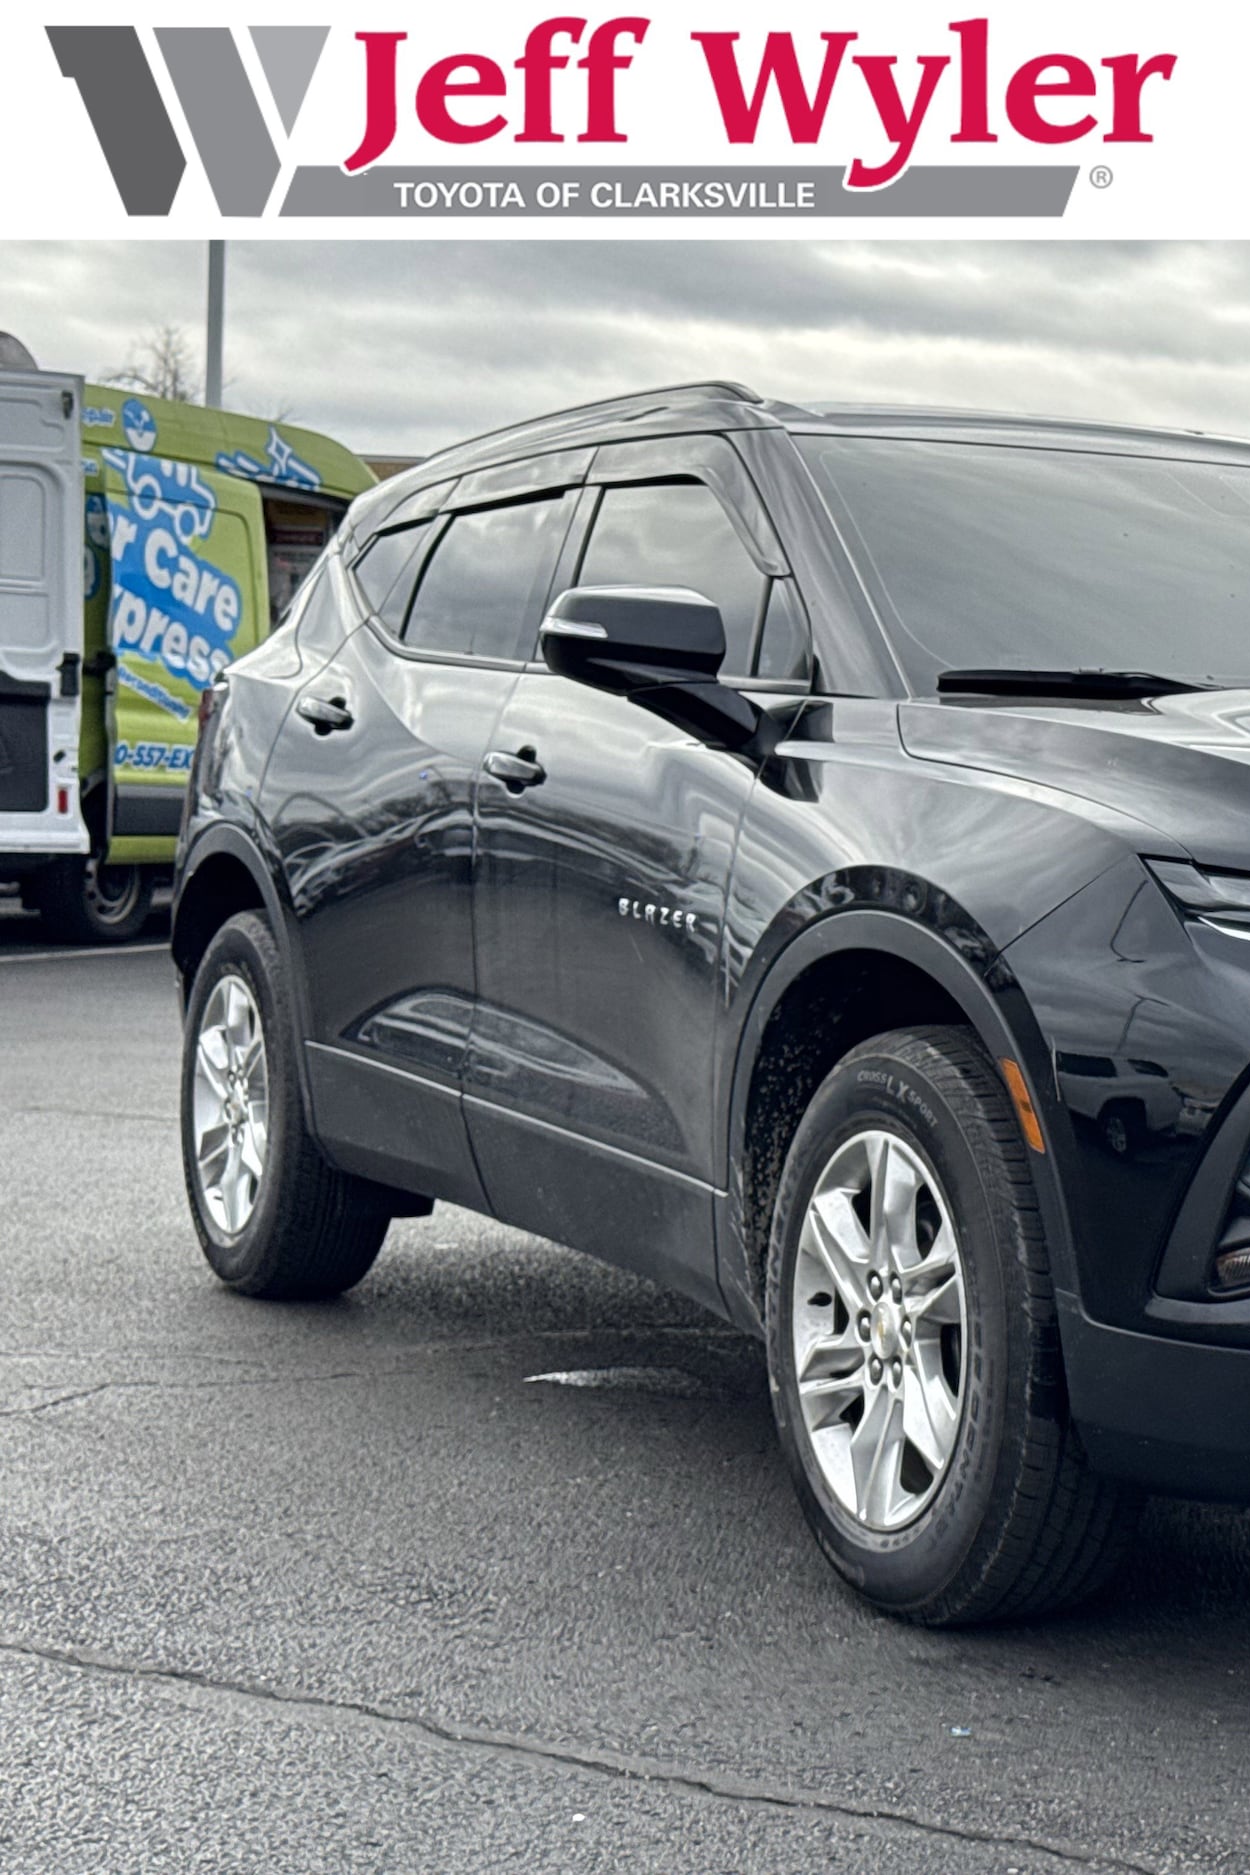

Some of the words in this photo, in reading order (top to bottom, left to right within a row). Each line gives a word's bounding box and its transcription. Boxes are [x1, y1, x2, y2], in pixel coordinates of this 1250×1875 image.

[144, 527, 239, 632] Care
[111, 583, 231, 686] press
[618, 897, 697, 933] BLAZER
